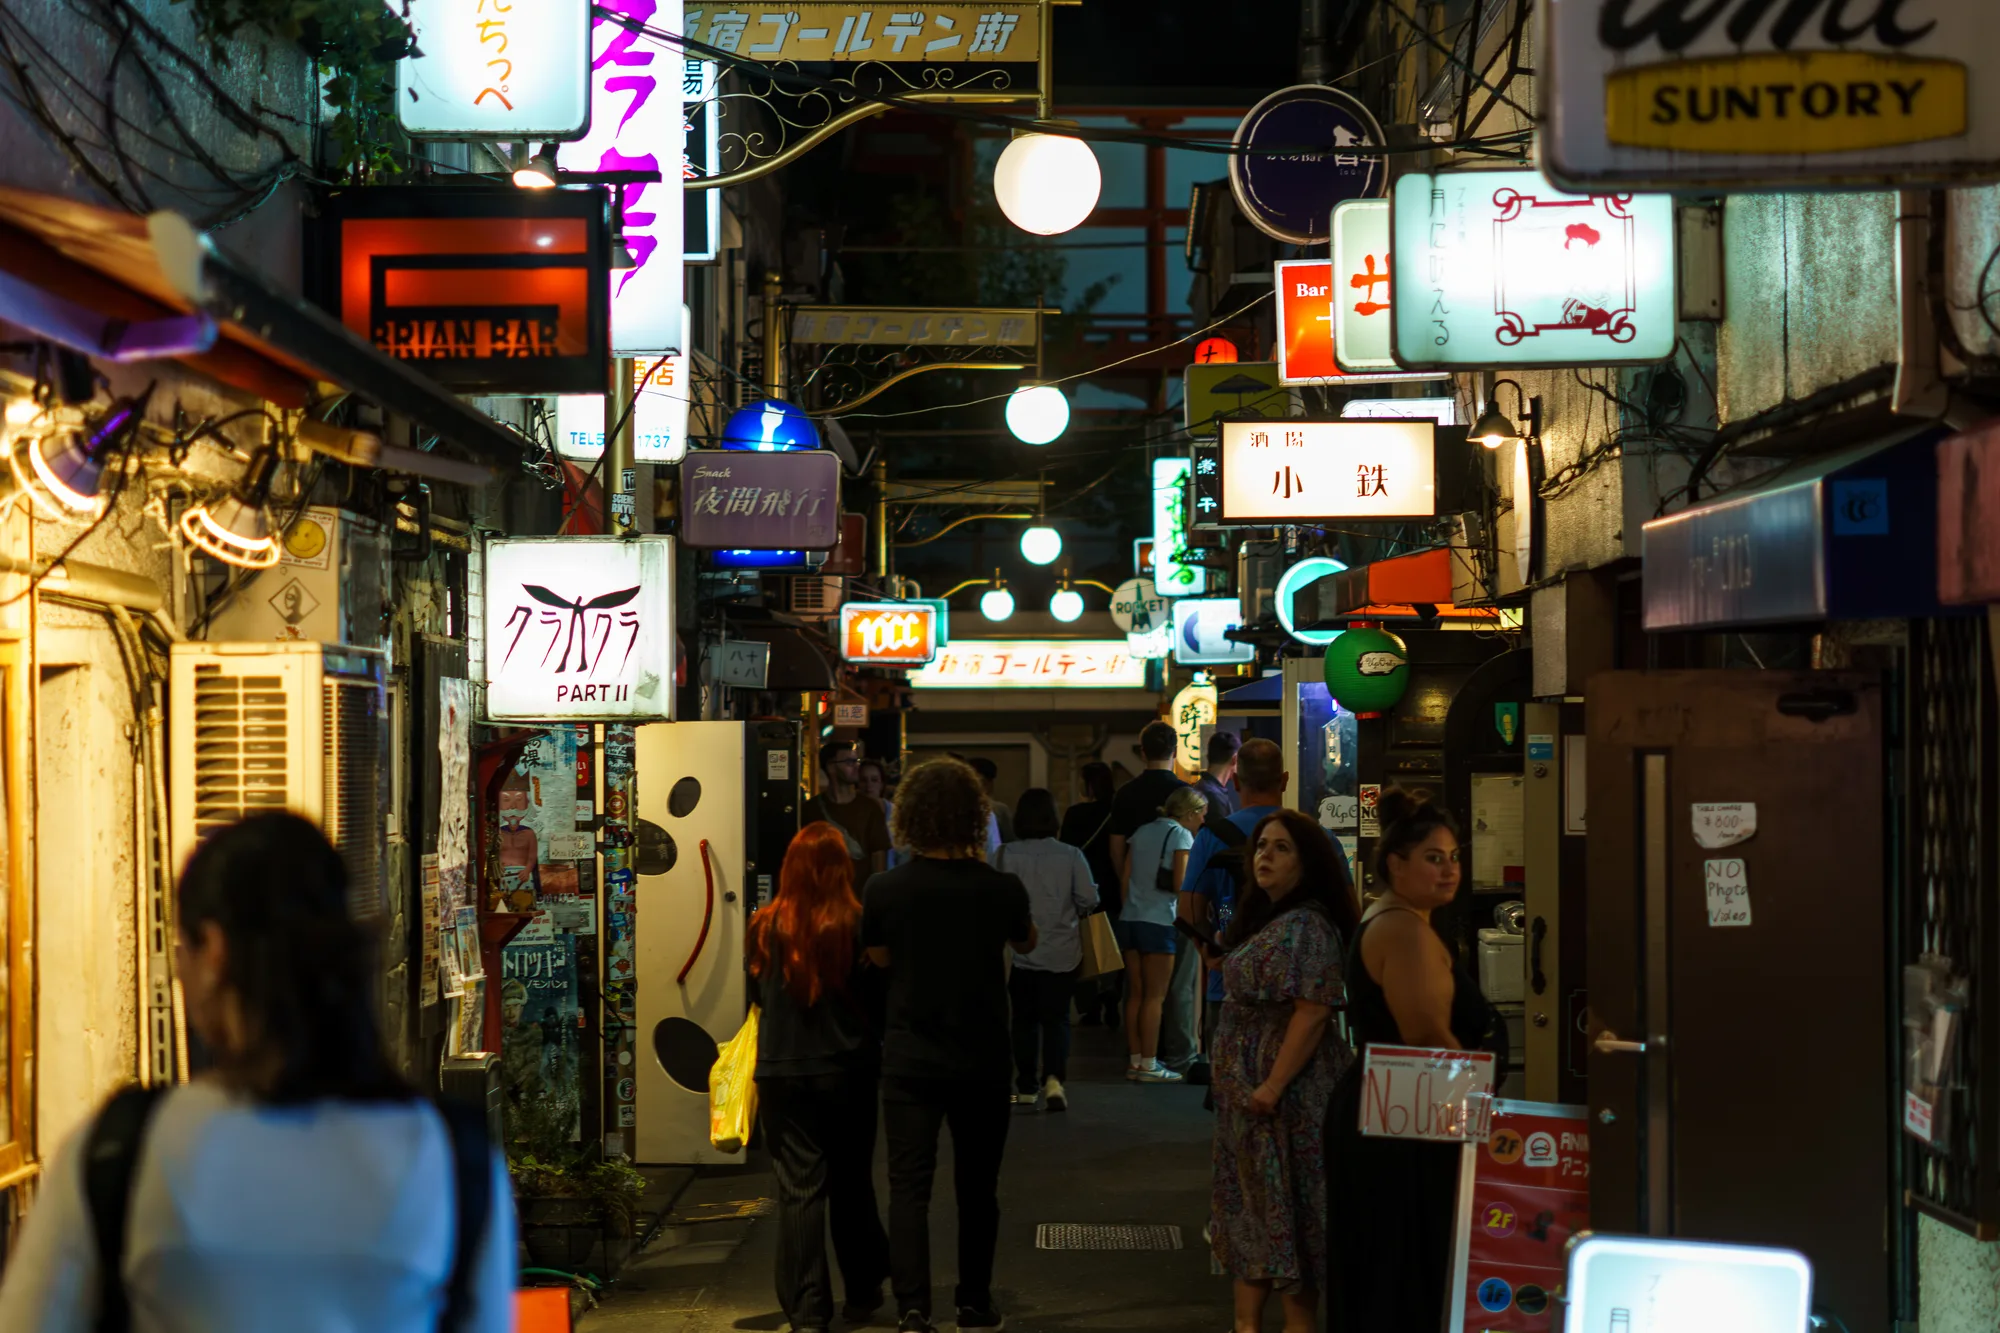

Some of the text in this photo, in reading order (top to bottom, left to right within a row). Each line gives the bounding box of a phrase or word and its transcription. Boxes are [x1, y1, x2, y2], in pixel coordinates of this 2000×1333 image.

[1651, 79, 1926, 125] SUNTORY
[1296, 283, 1328, 298] Bar
[375, 320, 559, 359] BRIAN BAR
[692, 466, 732, 479] Snack
[1272, 464, 1389, 499] 小鉄
[692, 486, 826, 516] 夜間飛行
[1116, 603, 1164, 615] ROCKET
[557, 684, 611, 702] PART
[1707, 861, 1741, 879] NO
[1708, 882, 1747, 897] Photo
[1711, 909, 1747, 923] Video
[1365, 1068, 1408, 1135] No
[1496, 1137, 1519, 1154] 2F
[1487, 1209, 1514, 1229] 2F
[1485, 1283, 1508, 1303] 1F
